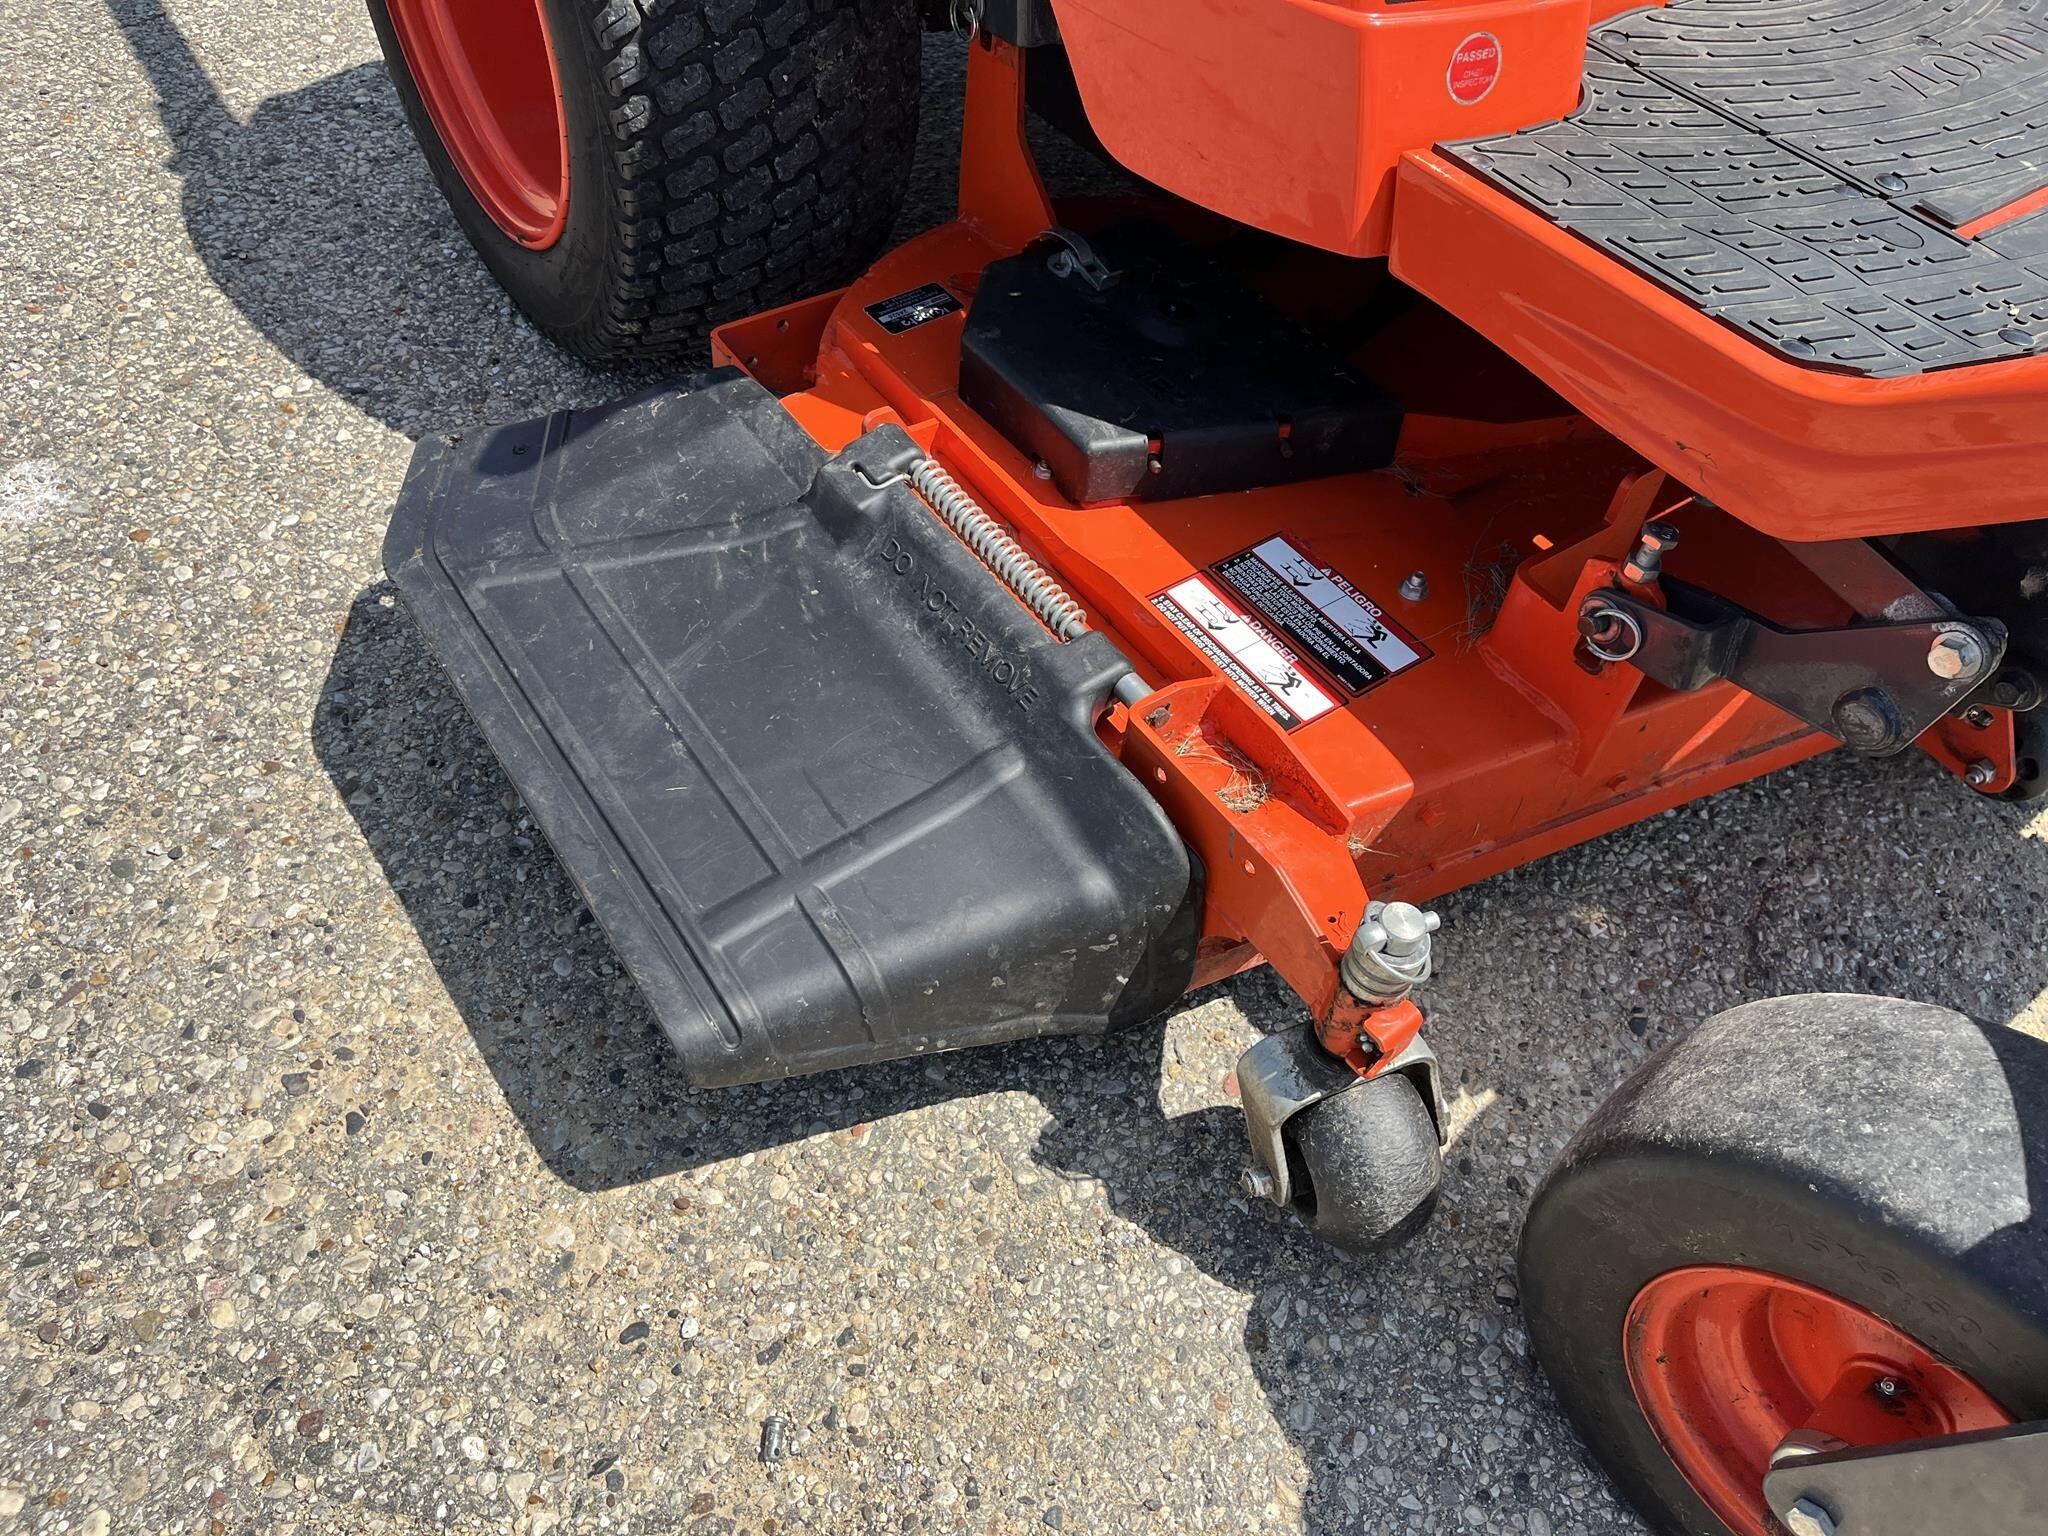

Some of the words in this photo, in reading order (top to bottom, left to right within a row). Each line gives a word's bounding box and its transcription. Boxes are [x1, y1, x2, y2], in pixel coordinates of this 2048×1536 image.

[1456, 47, 1495, 63] PASSED
[899, 305, 950, 328] Kubota
[1221, 570, 1251, 595] DEFLECTOR
[1248, 594, 1259, 602] DE
[1232, 565, 1258, 586] MIENTRAS
[1262, 591, 1283, 608] MOTOR
[1292, 618, 1303, 626] EN
[1243, 559, 1271, 583] DESCARGA
[1276, 588, 1293, 601] TODO
[1329, 575, 1383, 617] PELIGRO
[879, 538, 914, 577] DO
[916, 572, 963, 630] NOT
[957, 621, 1041, 713] REMOVE
[1226, 567, 1237, 575] NO
[1234, 574, 1251, 587] HAGA
[1247, 586, 1278, 611] FUNCIONAR
[1274, 610, 1285, 618] LA
[1281, 616, 1315, 645] CORTADORA
[1311, 643, 1324, 653] SIN
[1320, 651, 1331, 659] EL
[1237, 562, 1248, 570] NO
[1245, 568, 1271, 590] COLOQUE
[1268, 588, 1281, 598] LAS
[1278, 597, 1298, 614] MANOS
[1301, 618, 1315, 628] LOS
[1311, 627, 1327, 638] PIES
[1323, 637, 1334, 645] EN
[1330, 643, 1341, 651] LA
[1338, 650, 1373, 679] CORTADORA
[1248, 620, 1299, 664] DANGER
[1280, 584, 1305, 604] ALEJADO
[1302, 603, 1312, 611] DE
[1317, 616, 1347, 641] ABERTURA
[1343, 639, 1355, 647] DE
[1351, 646, 1362, 654] LA
[1155, 602, 1168, 612] DO
[1163, 610, 1178, 622] NOT
[1173, 620, 1189, 632] PUT
[1183, 629, 1206, 648] HANDS
[1201, 646, 1214, 656] OR
[1209, 654, 1225, 667] FEET
[1222, 666, 1240, 681] INTO
[1235, 678, 1260, 700] MOWER
[1255, 697, 1276, 716] WHEN
[1162, 599, 1180, 614] STAY
[1175, 612, 1195, 629] CLEAR
[1192, 628, 1203, 636] OF
[1199, 634, 1232, 664] DISCHARGE
[1228, 662, 1255, 686] OPENING
[1251, 683, 1264, 693] AT
[1259, 691, 1274, 703] ALL
